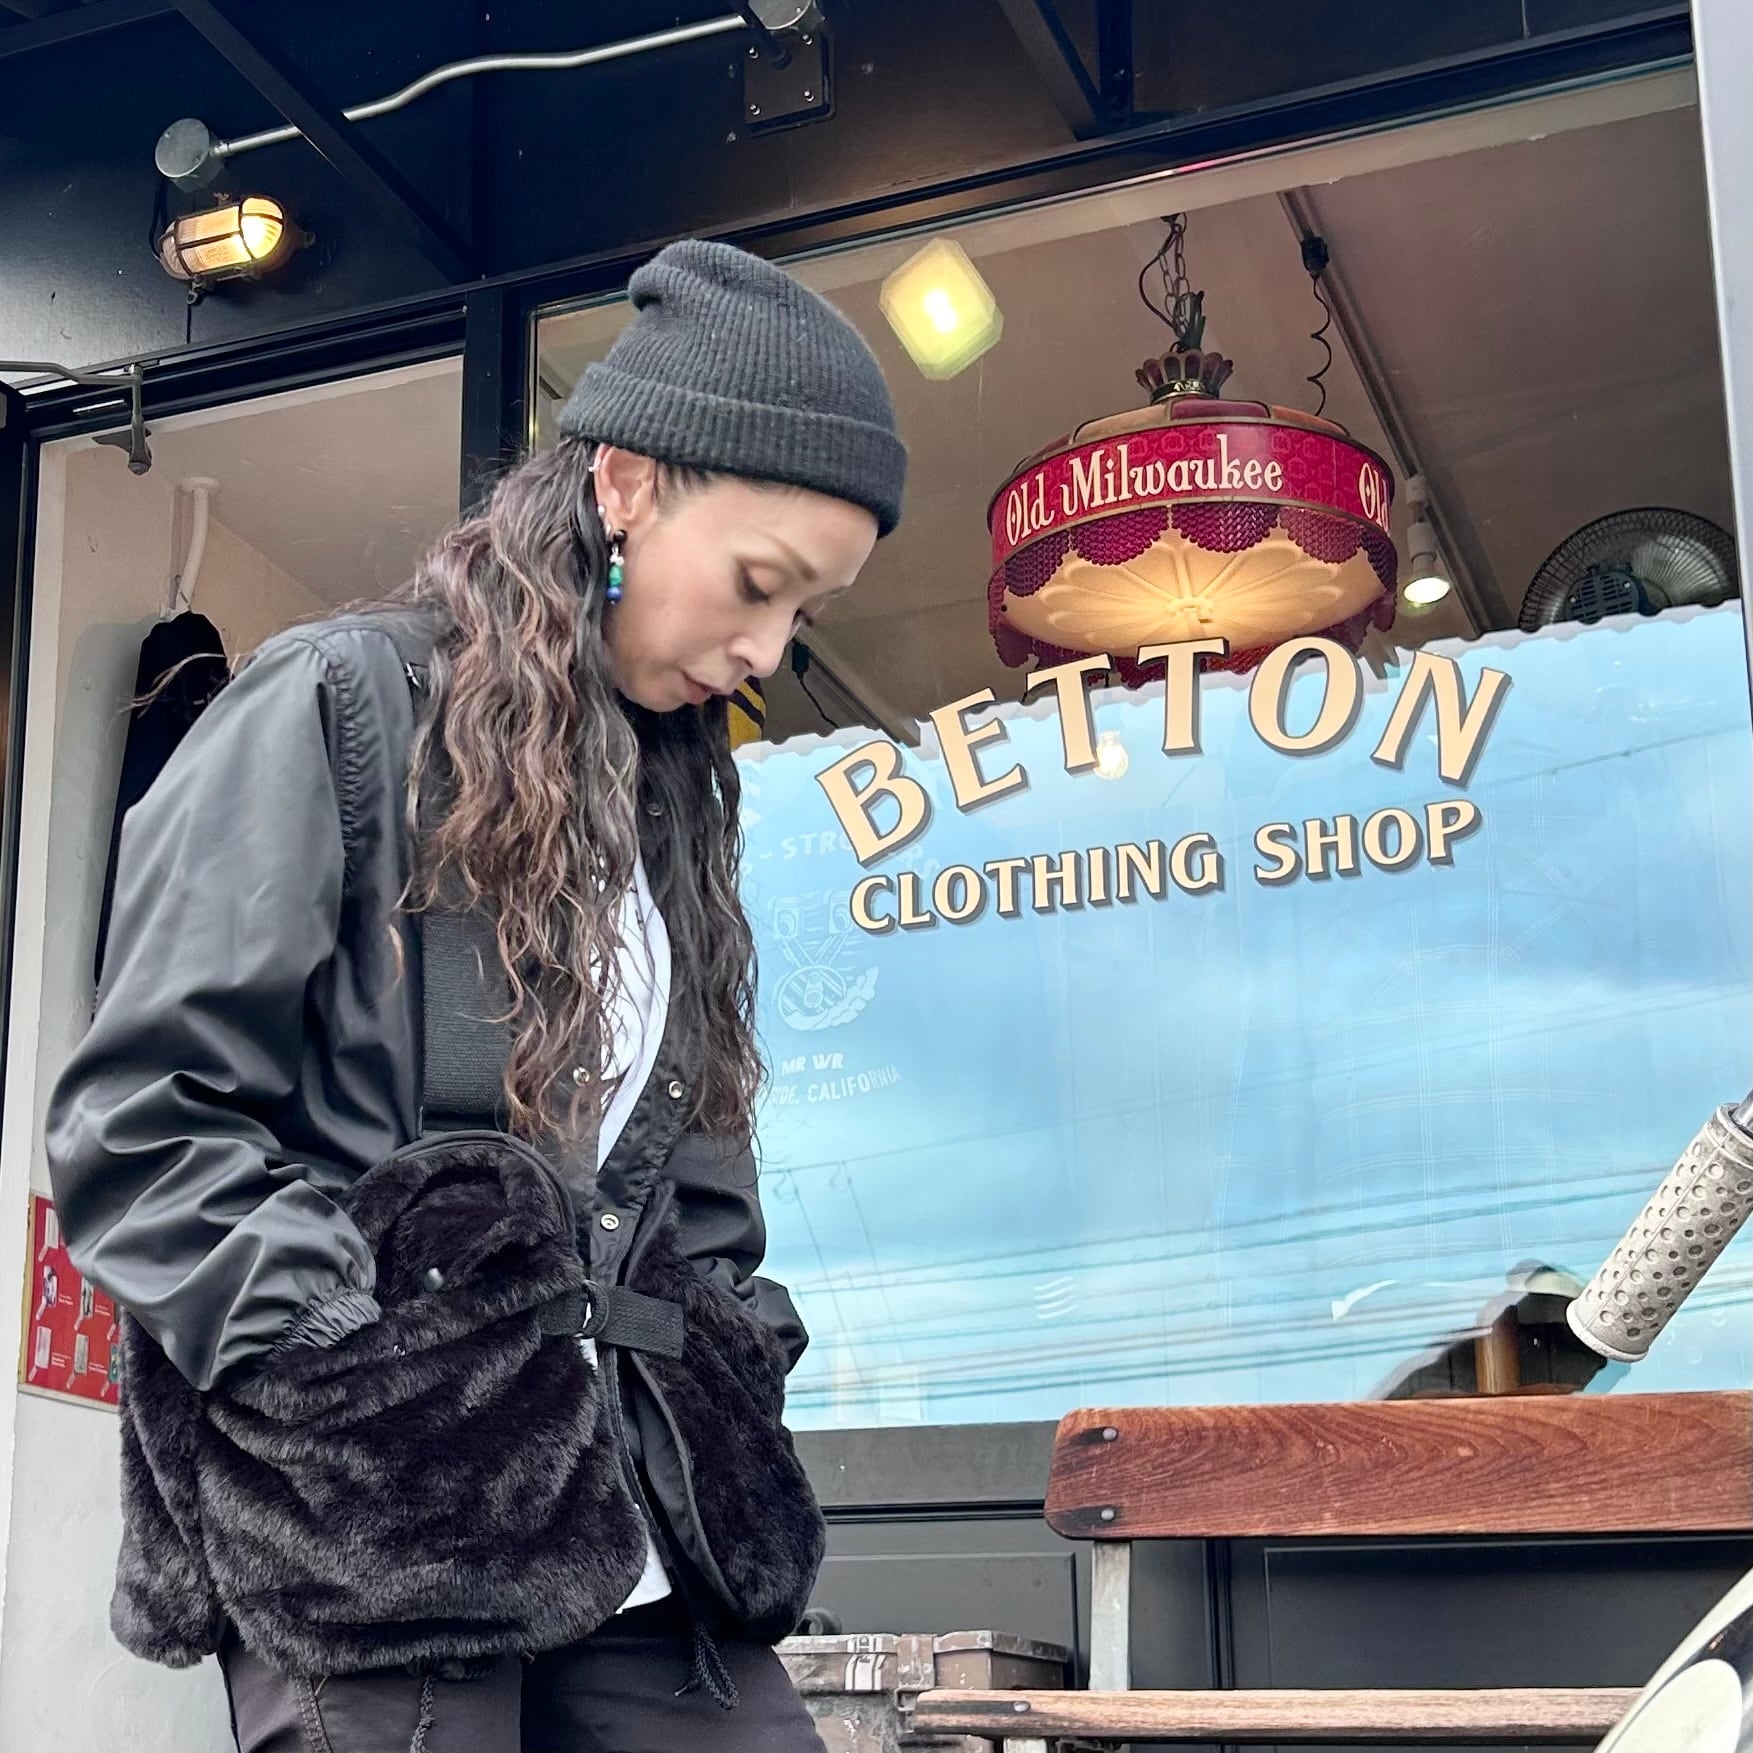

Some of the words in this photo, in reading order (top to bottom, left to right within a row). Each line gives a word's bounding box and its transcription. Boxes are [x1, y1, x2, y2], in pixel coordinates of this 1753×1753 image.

[1006, 472, 1055, 546] Old
[1060, 433, 1283, 516] Milwaukee
[813, 636, 1513, 871] BETTON
[850, 832, 1226, 935] CLOTHING
[1253, 800, 1484, 888] SHOP
